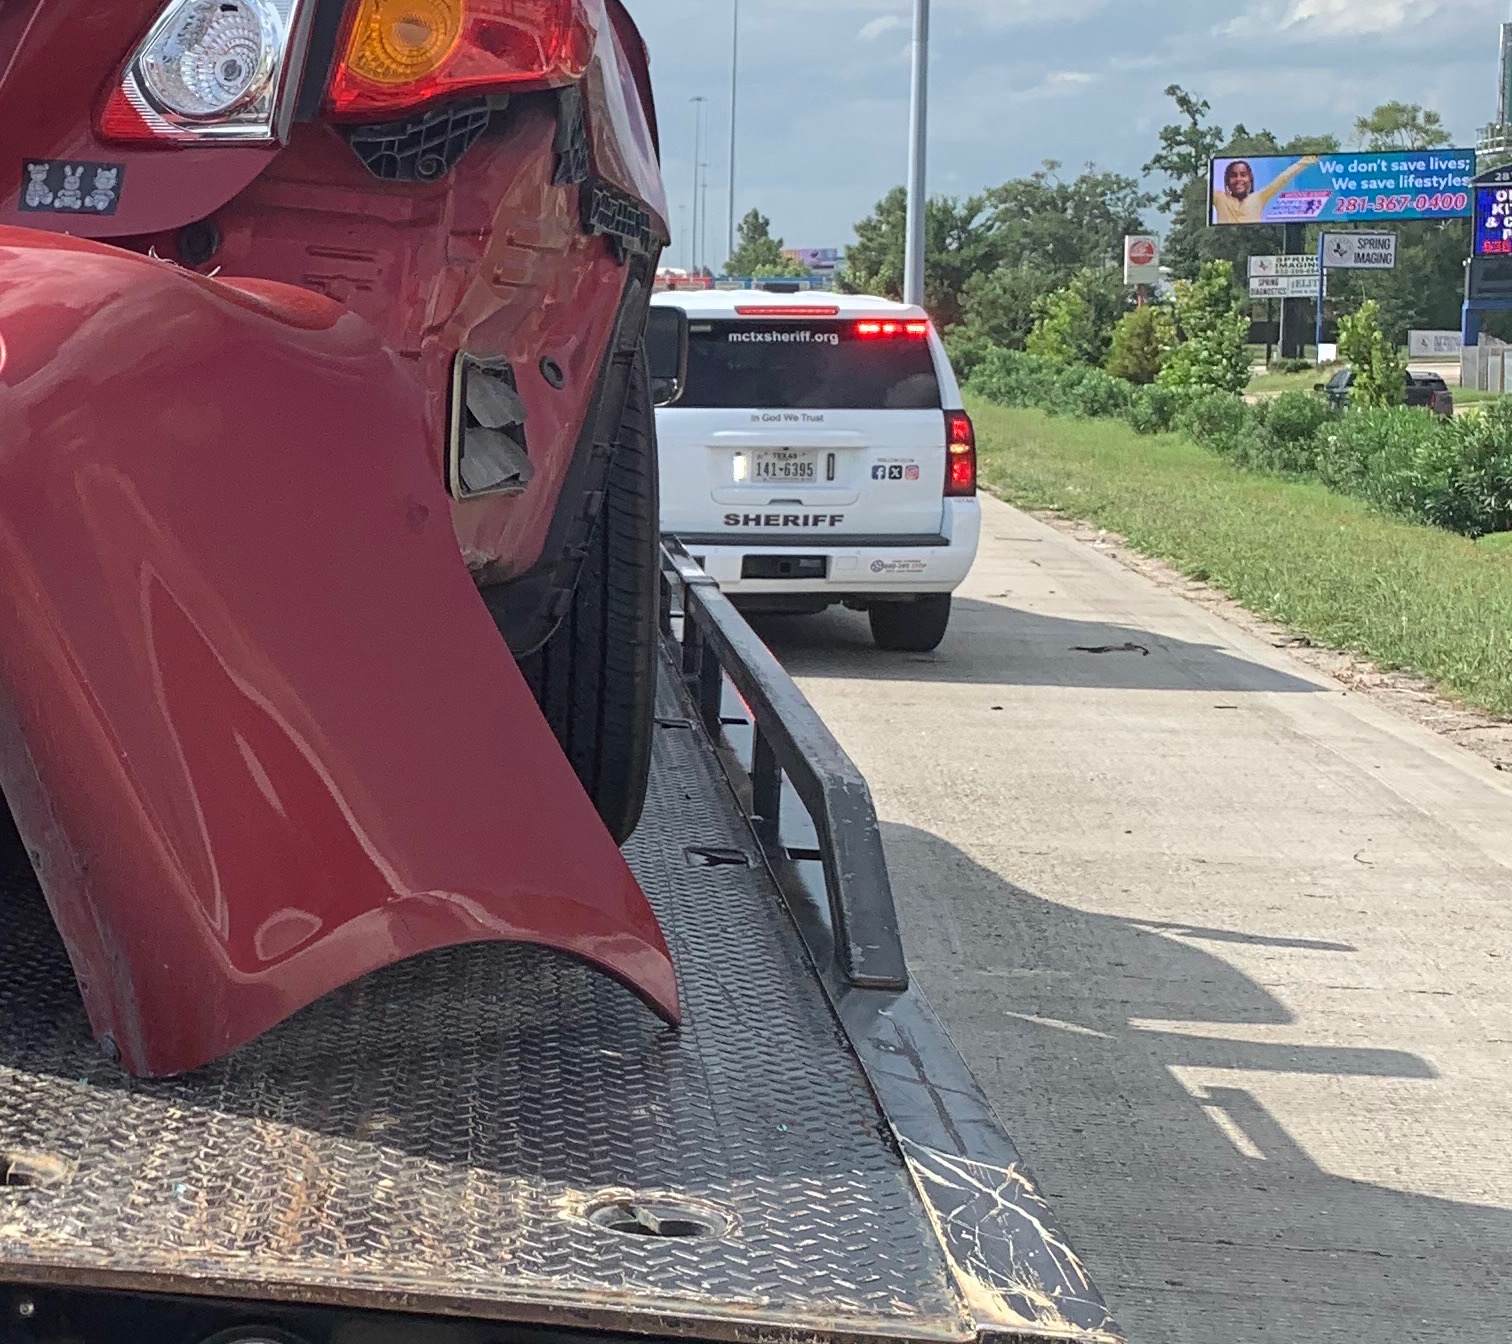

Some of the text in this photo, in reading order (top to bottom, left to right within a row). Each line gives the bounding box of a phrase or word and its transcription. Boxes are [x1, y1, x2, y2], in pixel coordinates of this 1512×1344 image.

[1320, 157, 1471, 173] We don't save lives;
[1332, 178, 1356, 190] We
[1360, 178, 1395, 190] save
[1334, 193, 1468, 213] 281-367-0400
[1357, 238, 1390, 250] SPRING
[1354, 252, 1392, 265] IMAGING
[728, 331, 839, 345] mctxsheriff.org
[750, 413, 824, 422] In God We Trust
[724, 513, 844, 527] SHERIFF
